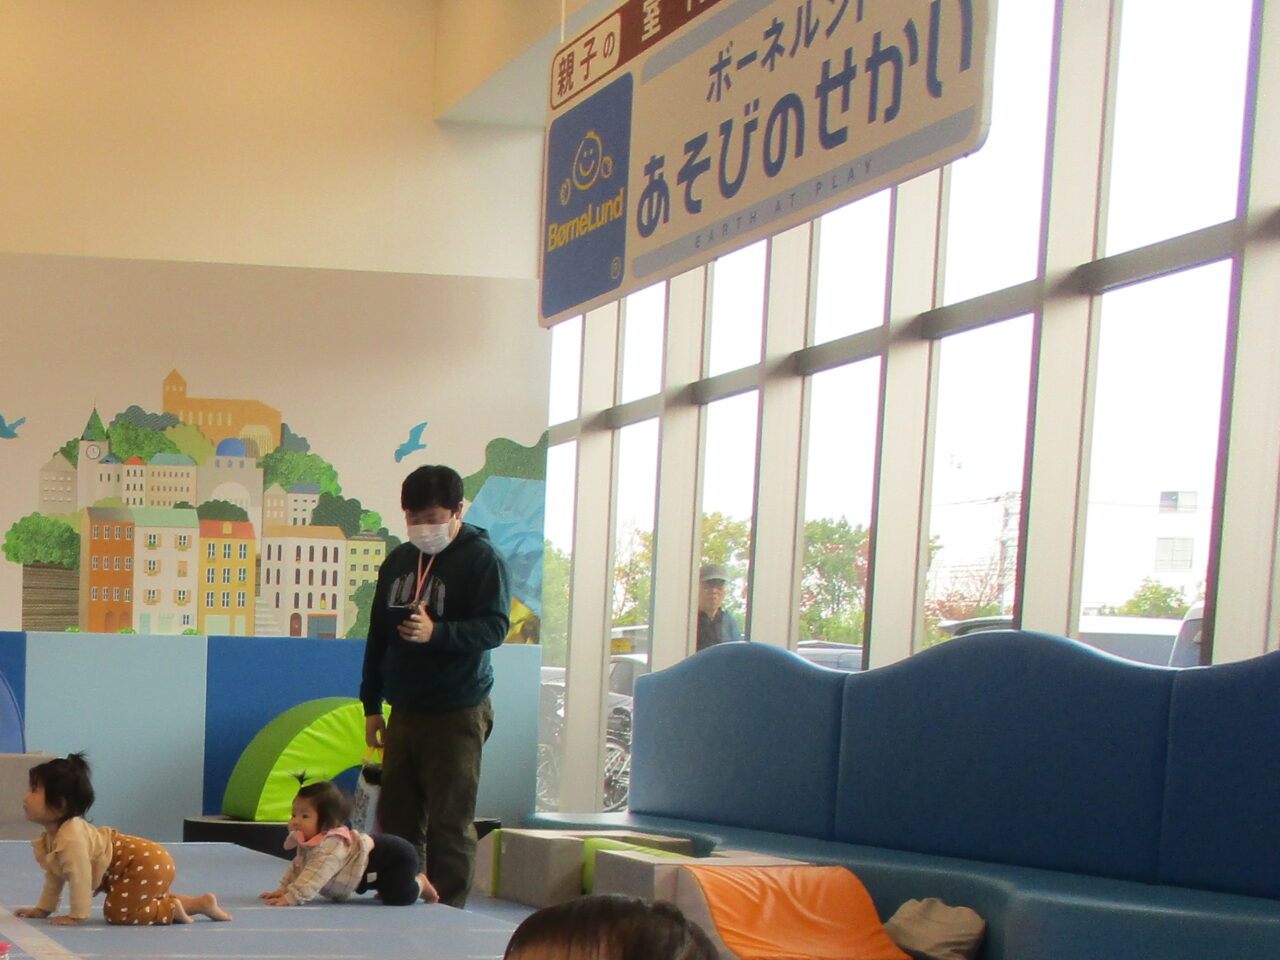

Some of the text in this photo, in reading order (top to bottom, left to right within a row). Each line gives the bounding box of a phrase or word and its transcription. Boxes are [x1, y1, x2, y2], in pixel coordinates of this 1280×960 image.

[557, 31, 616, 98] 親子の
[636, 0, 973, 239] あそびのせかい
[695, 159, 872, 249] EARTH AT PLAY
